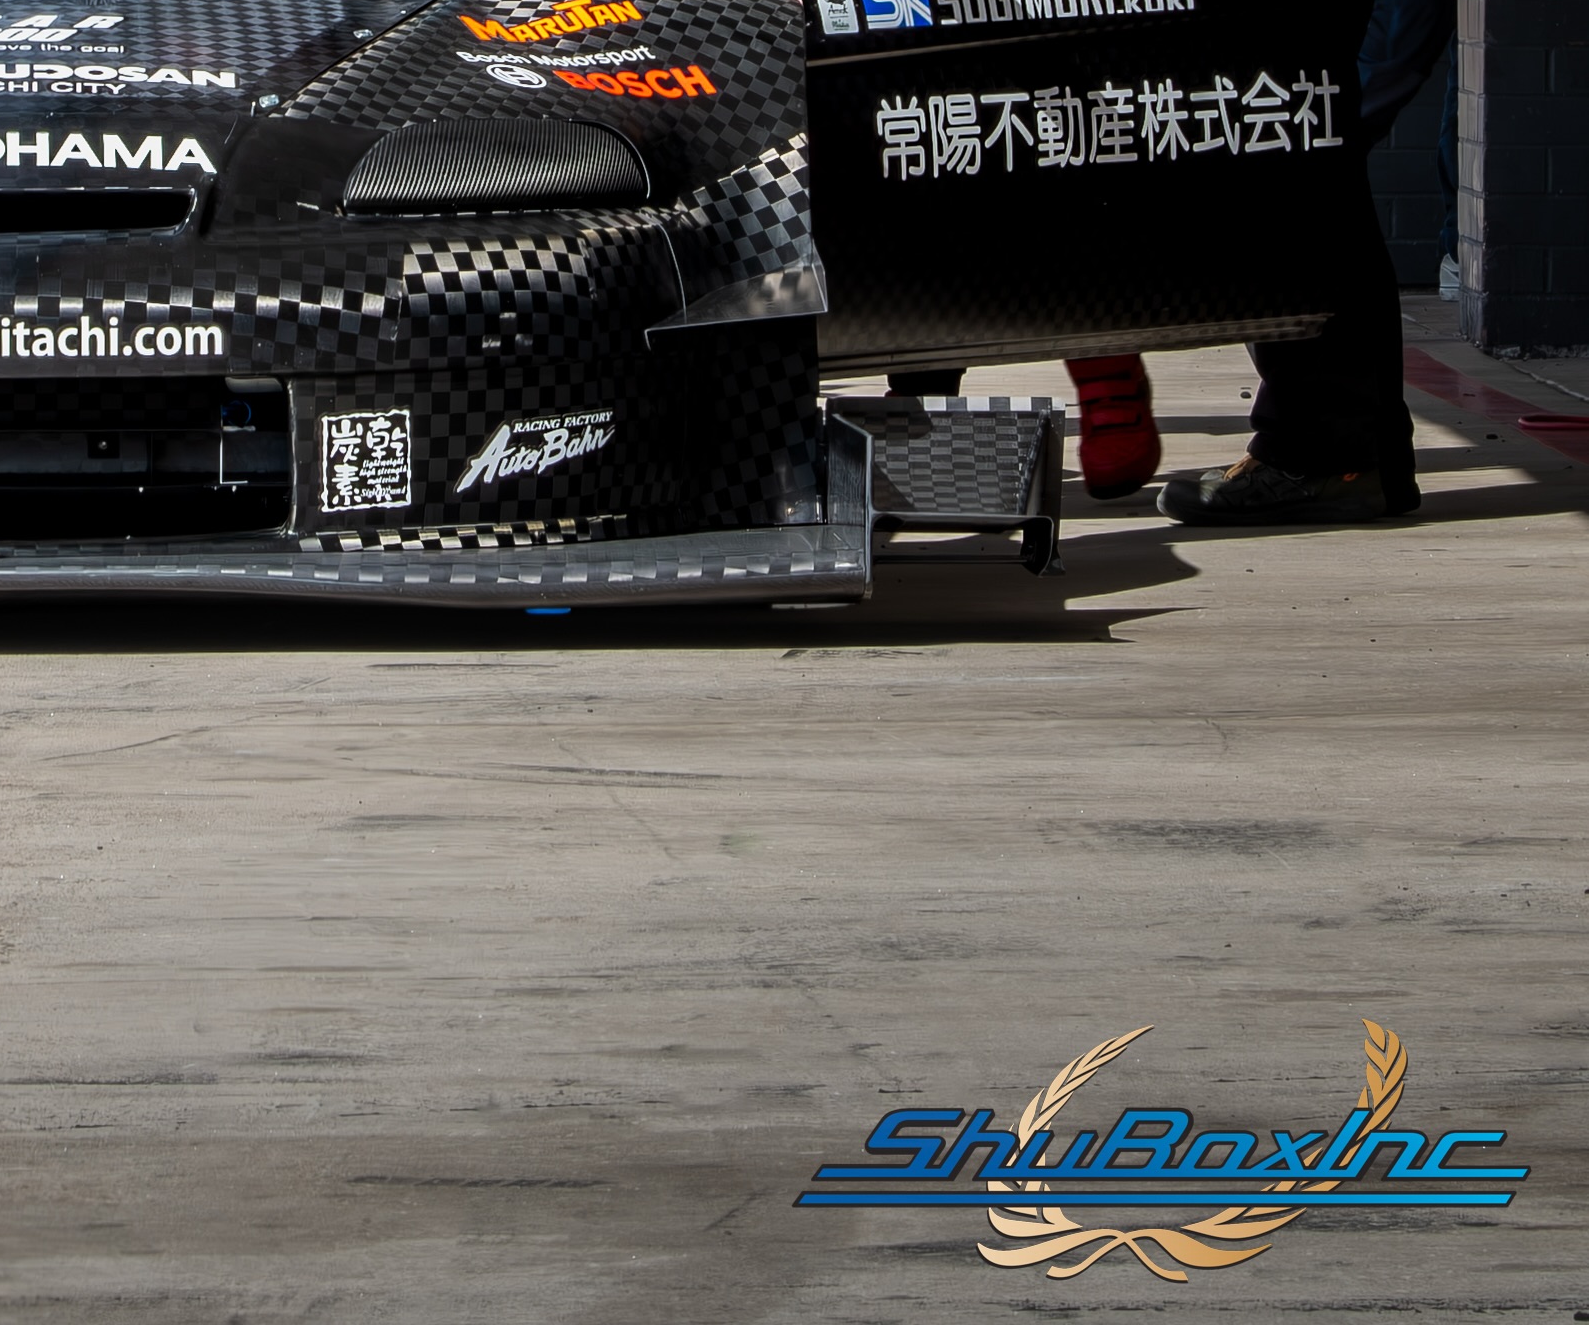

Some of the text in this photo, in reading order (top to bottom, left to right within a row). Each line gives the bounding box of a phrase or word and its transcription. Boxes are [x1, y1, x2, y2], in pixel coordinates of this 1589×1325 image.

[456, 45, 658, 68] Bosch Motorsport
[50, 81, 128, 95] CITY
[552, 64, 718, 99] BOSCH
[874, 68, 1344, 182] 常陽不動産株式会社
[512, 411, 613, 434] RACING FACTORY
